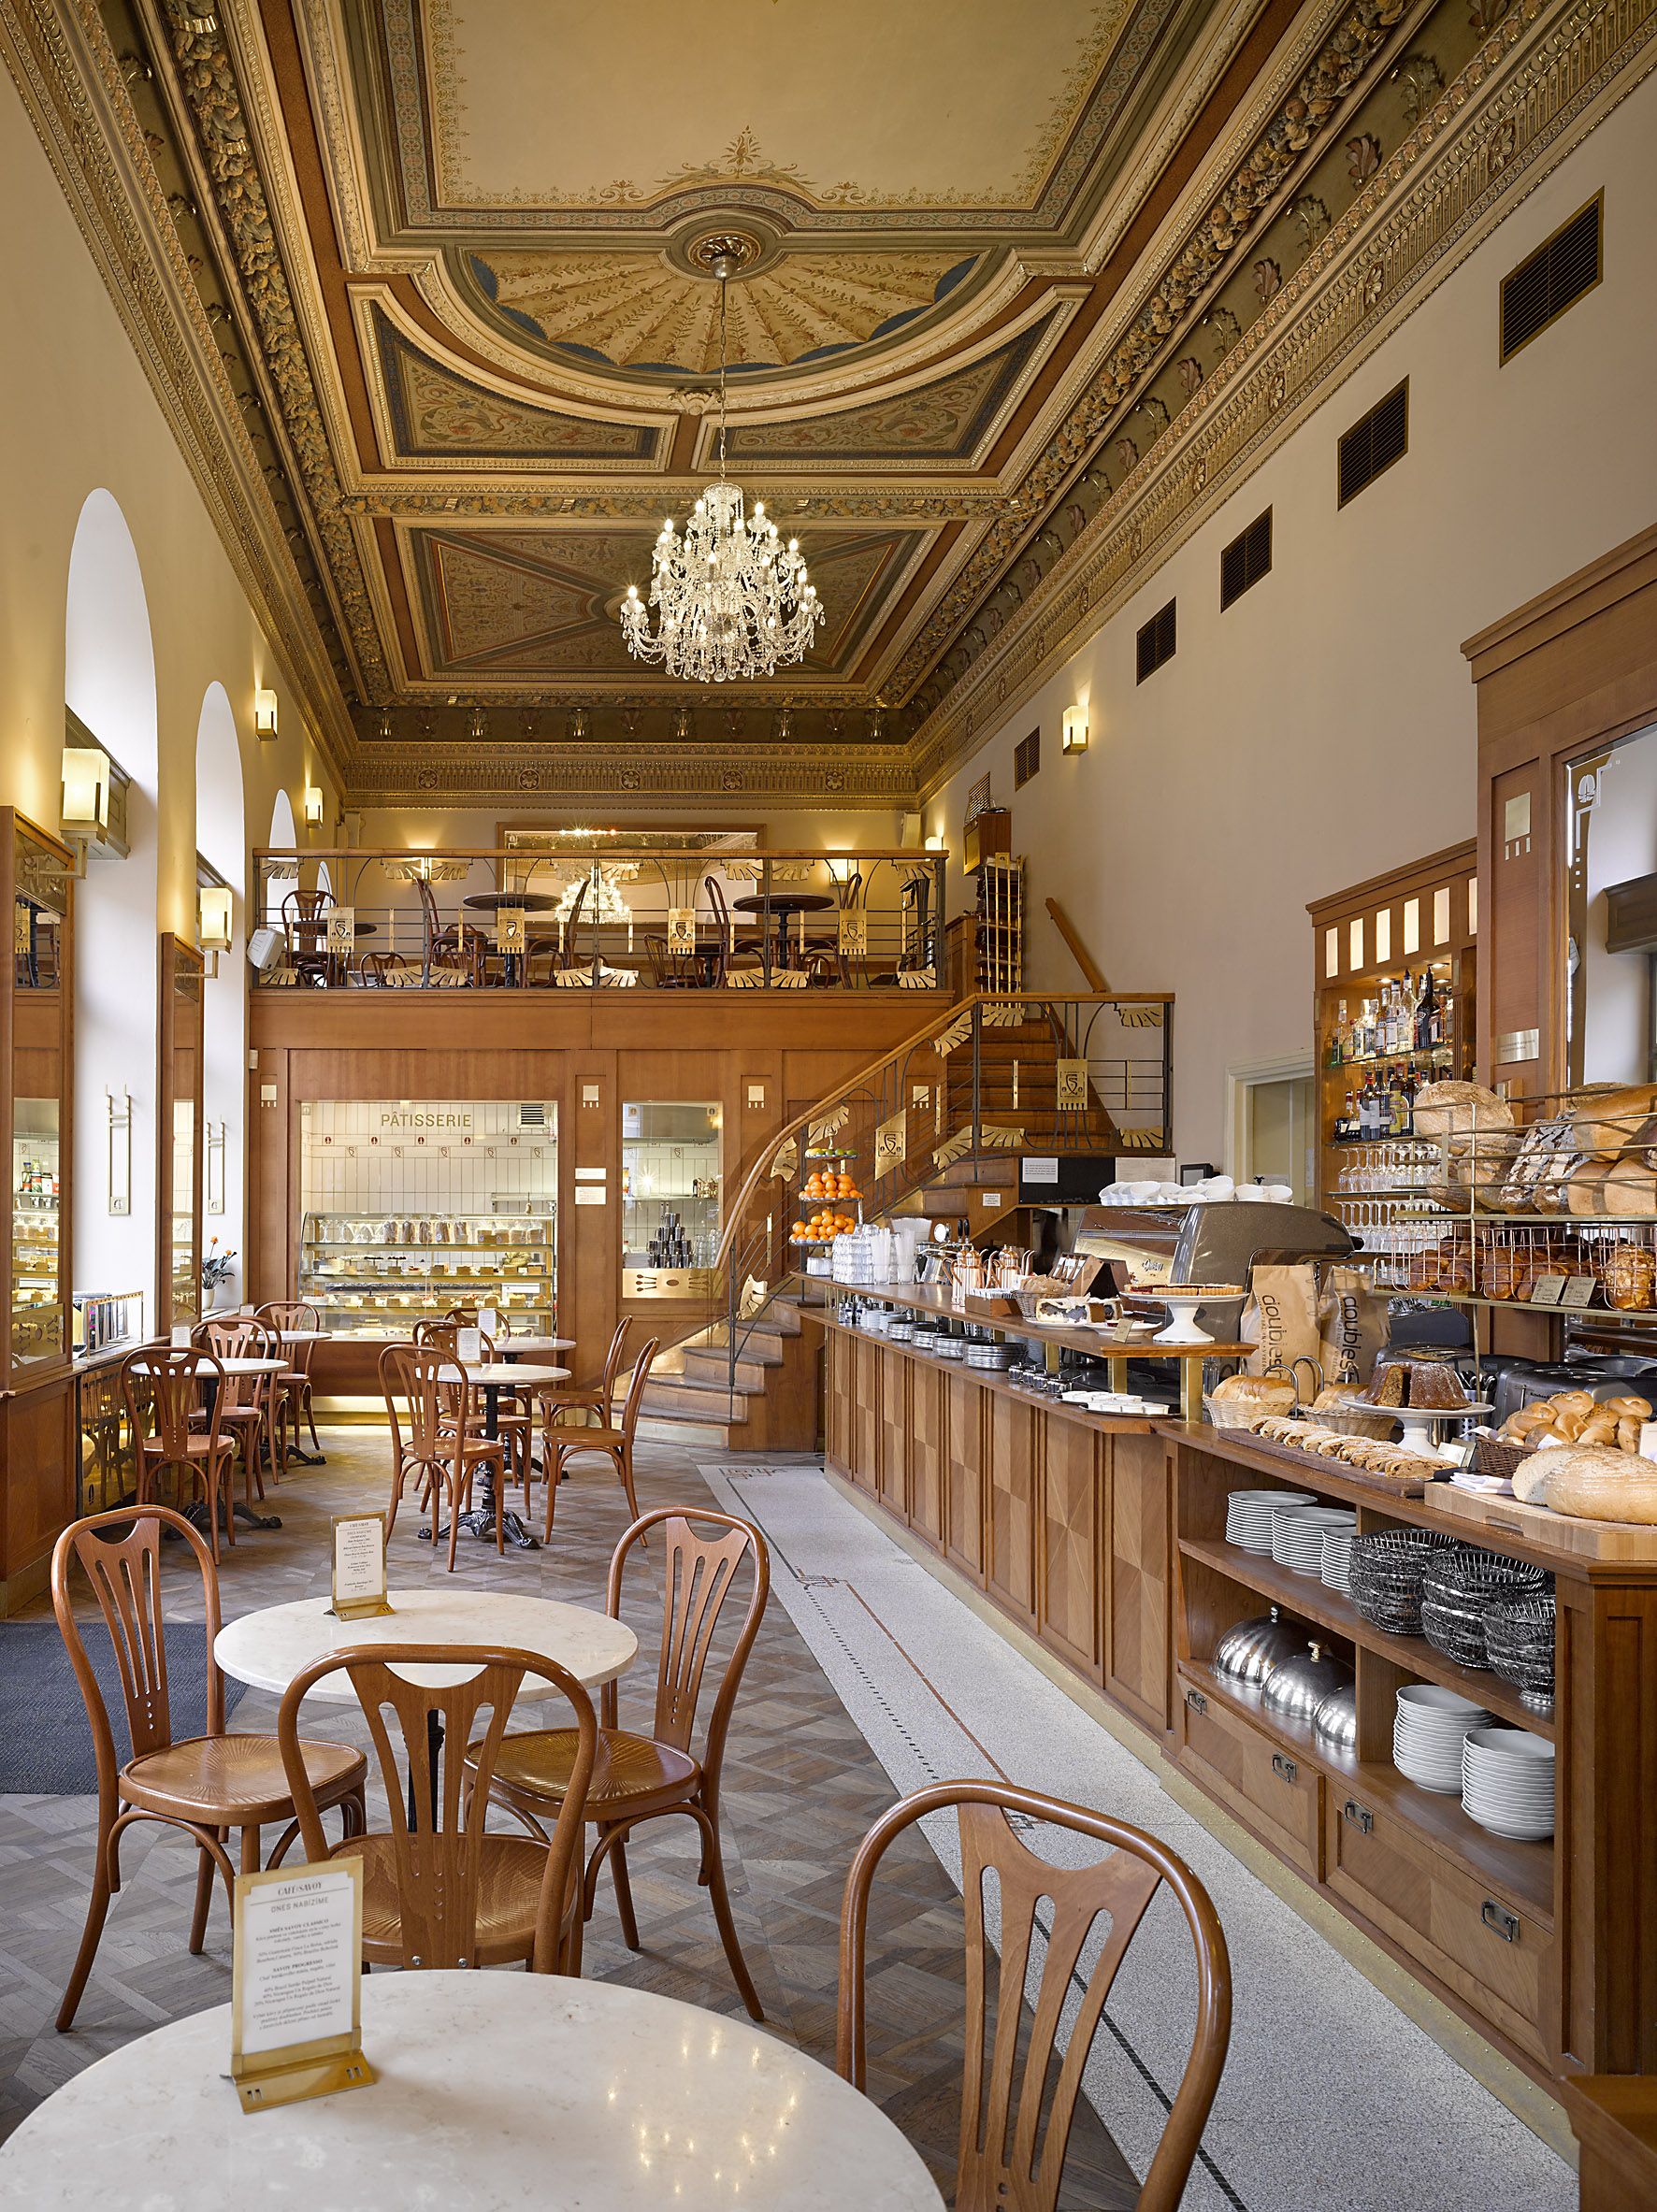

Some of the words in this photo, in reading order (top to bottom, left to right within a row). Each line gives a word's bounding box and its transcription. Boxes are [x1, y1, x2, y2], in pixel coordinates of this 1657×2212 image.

[381, 1111, 471, 1127] PÂTISSERIE
[1261, 1295, 1288, 1379] doublesh
[1337, 1296, 1362, 1384] doublesh
[271, 1903, 292, 1913] DNES
